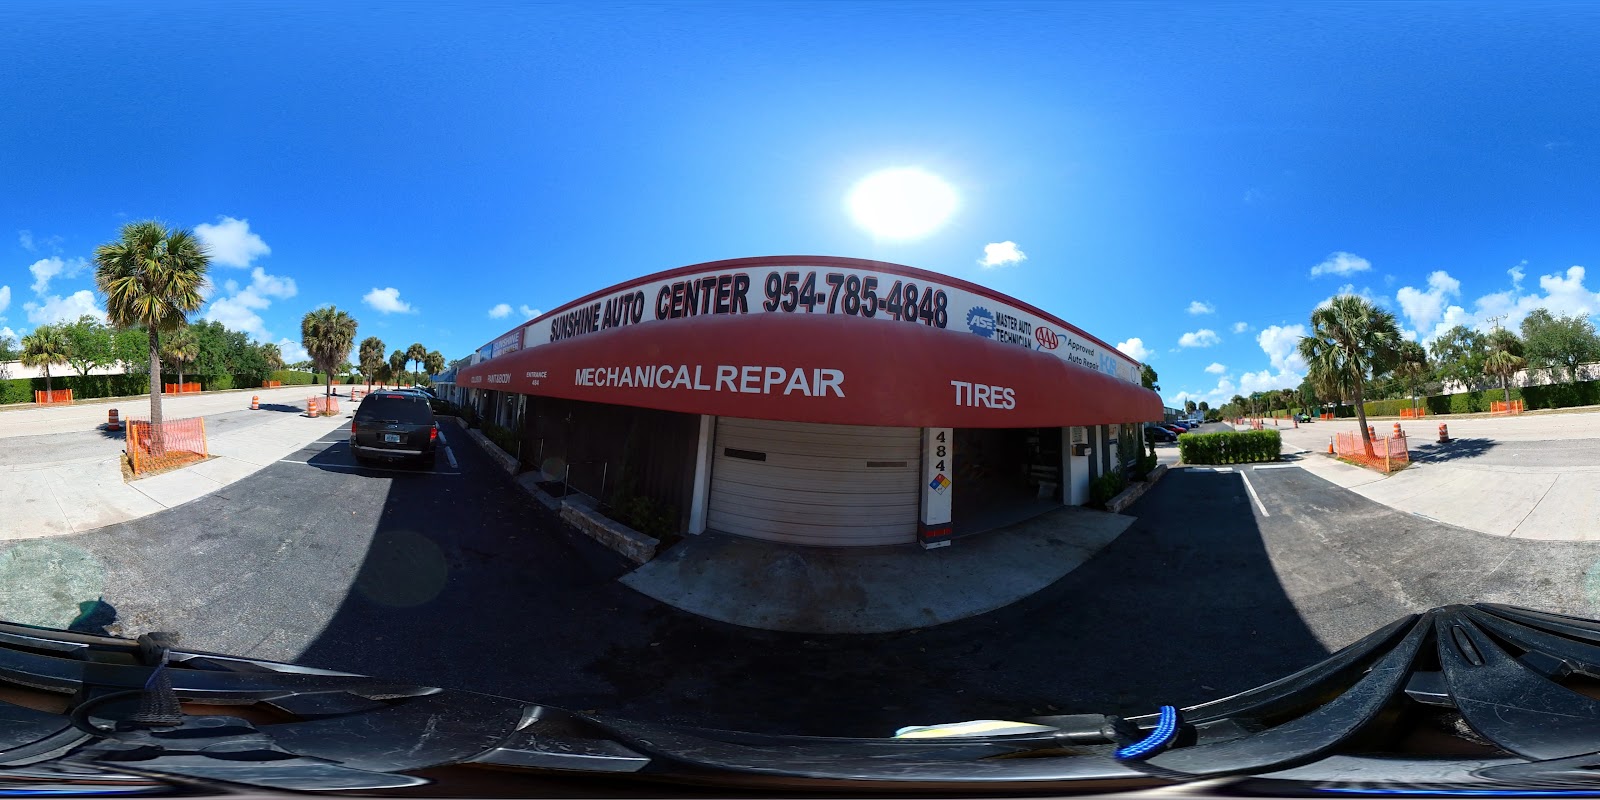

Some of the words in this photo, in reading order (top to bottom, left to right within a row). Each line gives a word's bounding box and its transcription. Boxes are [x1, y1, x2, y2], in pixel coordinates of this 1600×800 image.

[550, 302, 601, 342] SUNSHINE
[601, 290, 645, 331] AUTO
[655, 273, 750, 321] CENTER
[763, 271, 948, 329] 954-785-4848
[970, 315, 993, 330] ASE
[995, 311, 1018, 331] MASTER
[1018, 320, 1032, 336] AUTO
[995, 328, 1032, 349] TECHNICIAN
[1037, 328, 1056, 349] AAA
[1067, 338, 1095, 357] Approved
[1067, 352, 1083, 365] Auto
[1083, 357, 1099, 371] Repair
[526, 371, 548, 379] ENTRANCE
[574, 364, 711, 391] MECHANICAL
[715, 365, 846, 398] REPAIR
[950, 380, 1016, 410] TIRES
